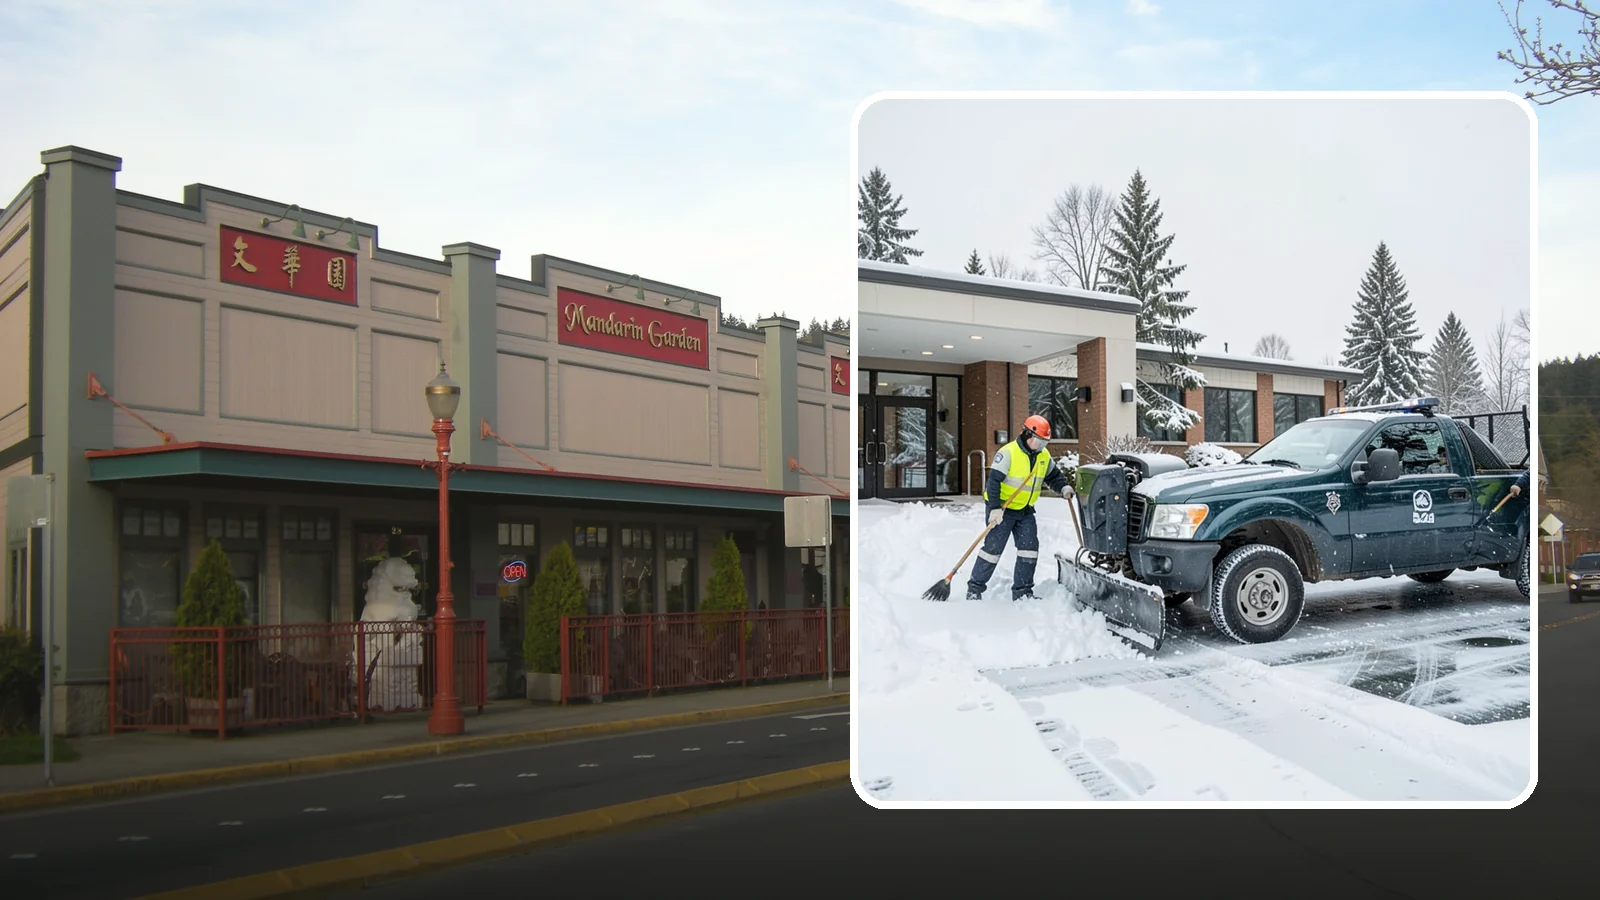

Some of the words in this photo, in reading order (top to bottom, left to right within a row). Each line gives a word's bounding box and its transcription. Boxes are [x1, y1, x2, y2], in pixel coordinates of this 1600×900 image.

[564, 302, 643, 341] Mandarin
[648, 320, 701, 352] Garden
[503, 565, 527, 578] OPEN
